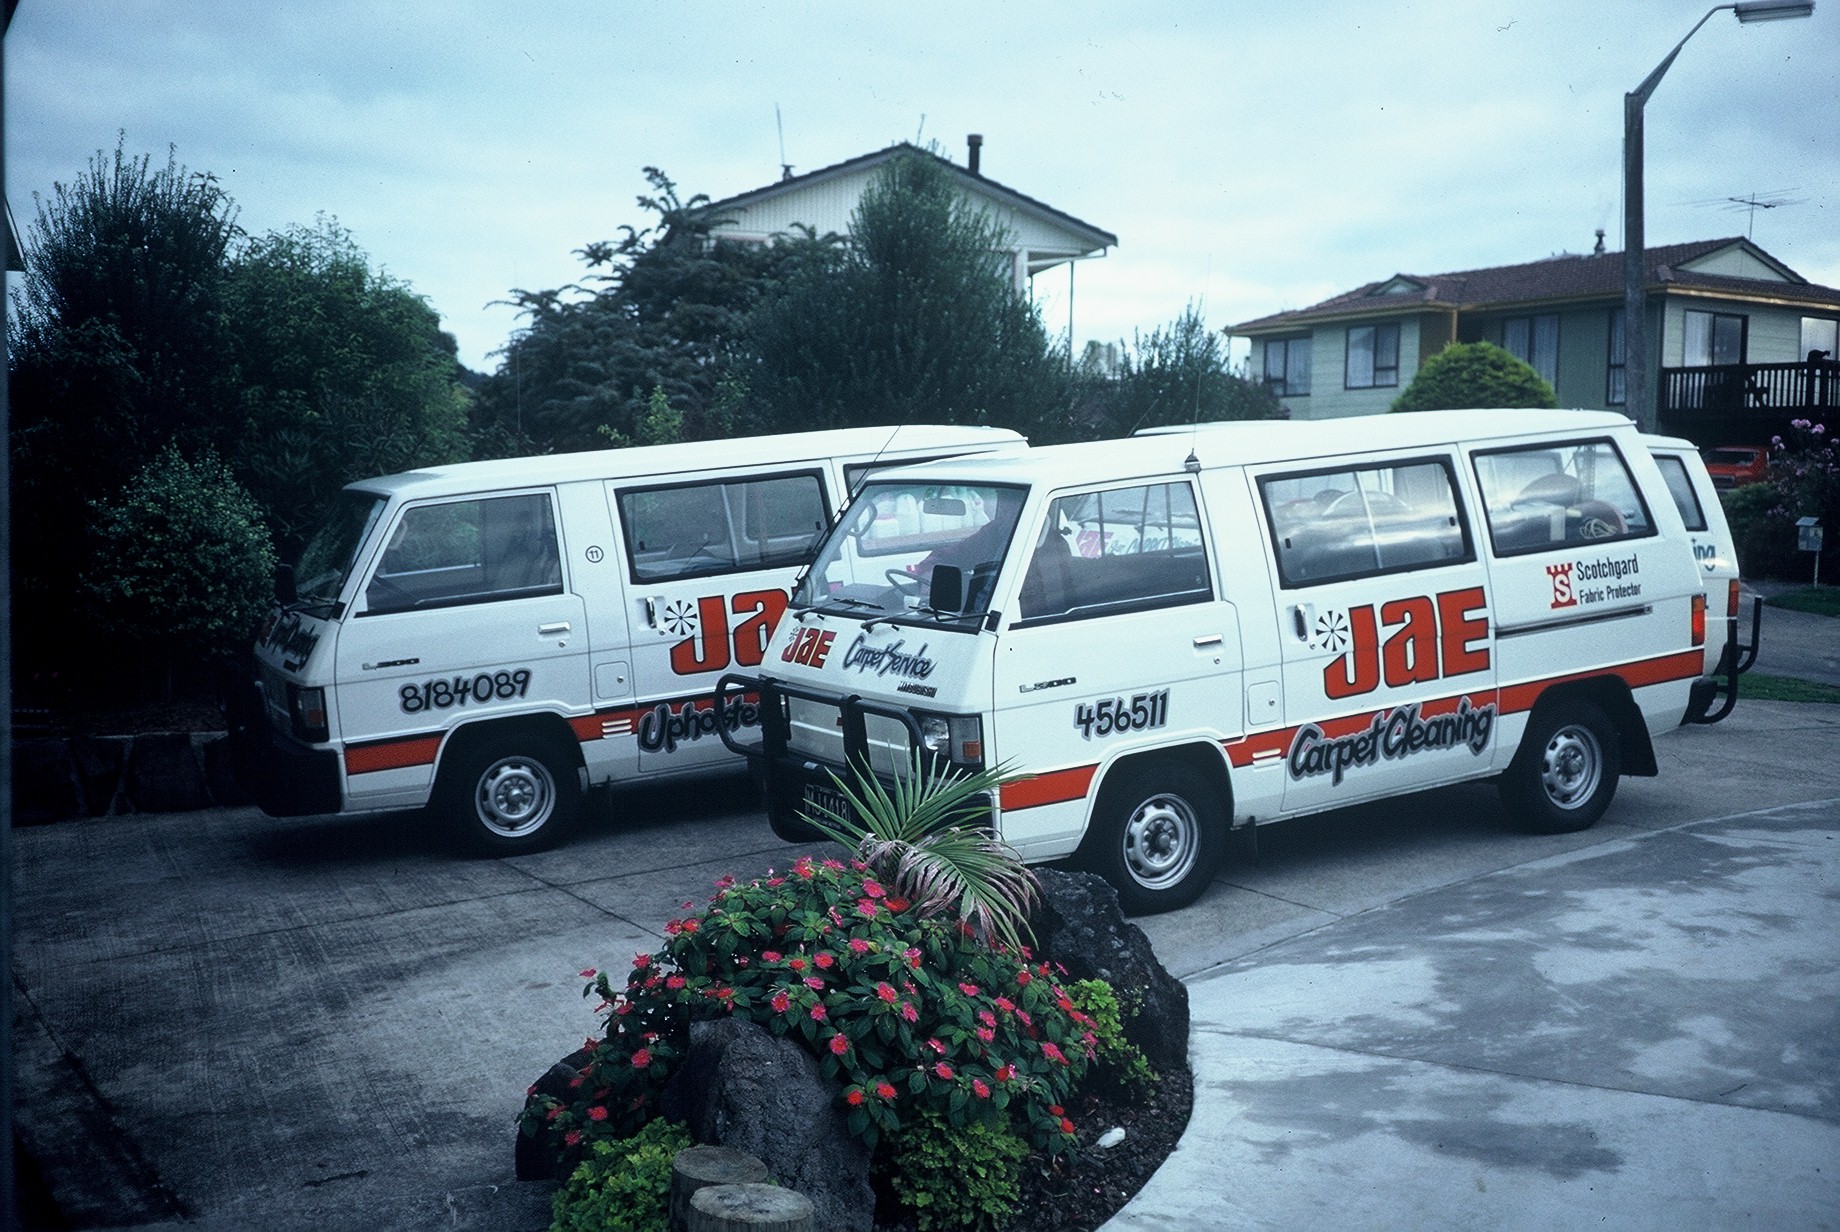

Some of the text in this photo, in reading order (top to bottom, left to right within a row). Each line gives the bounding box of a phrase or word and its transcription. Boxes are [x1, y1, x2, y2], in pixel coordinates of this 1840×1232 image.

[1577, 553, 1639, 581] Scotchgard
[1579, 583, 1641, 604] Fabric Protector
[842, 632, 937, 680] Carpet Service
[399, 668, 531, 714] 8184089
[1019, 677, 1077, 693] L300
[1074, 688, 1170, 741] 456511
[1289, 698, 1495, 785] Carpet Cleaning
